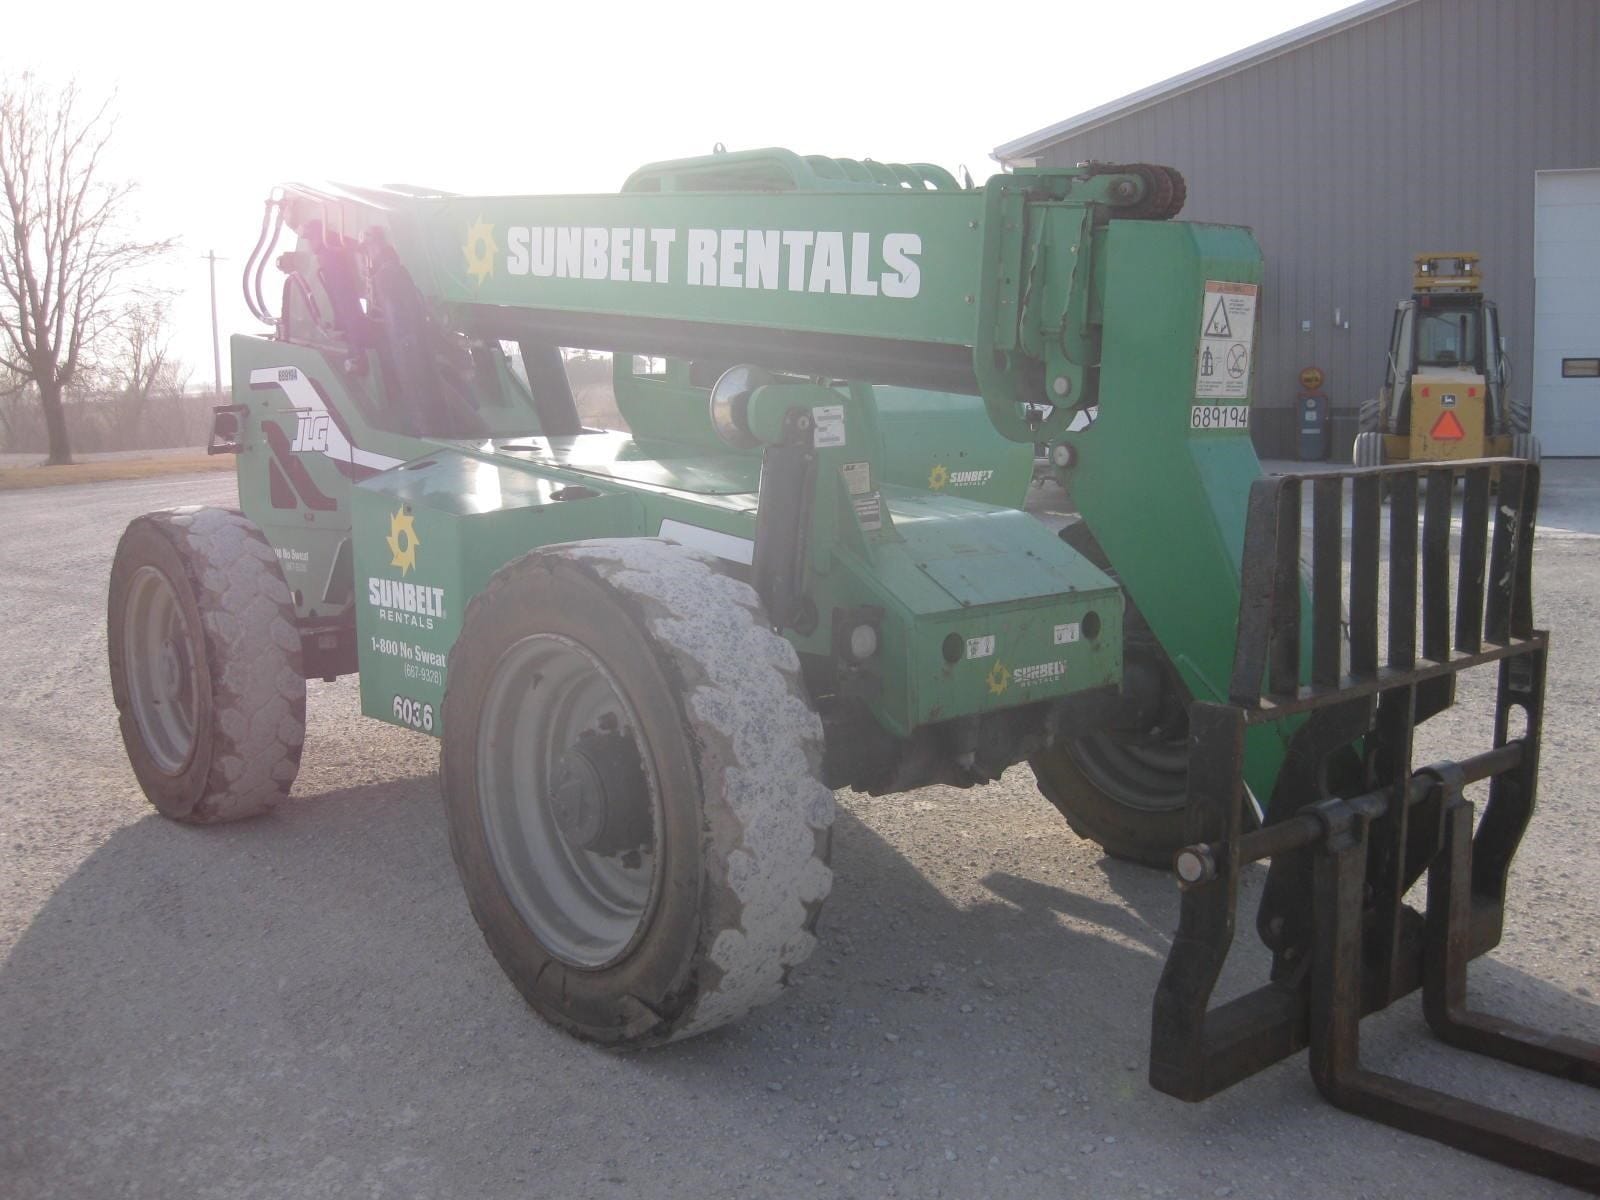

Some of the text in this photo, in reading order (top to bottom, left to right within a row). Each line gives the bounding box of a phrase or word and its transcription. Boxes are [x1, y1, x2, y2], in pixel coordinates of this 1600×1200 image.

[506, 226, 922, 299] SUNBELT RENTALS
[290, 415, 330, 452] JLG
[1191, 407, 1247, 428] 689194
[949, 469, 994, 483] SUNBELT
[368, 577, 444, 618] SUNBELT
[379, 608, 434, 630] RENTALS
[371, 636, 446, 668] 1-800 No Sweat
[393, 695, 433, 731] 6036
